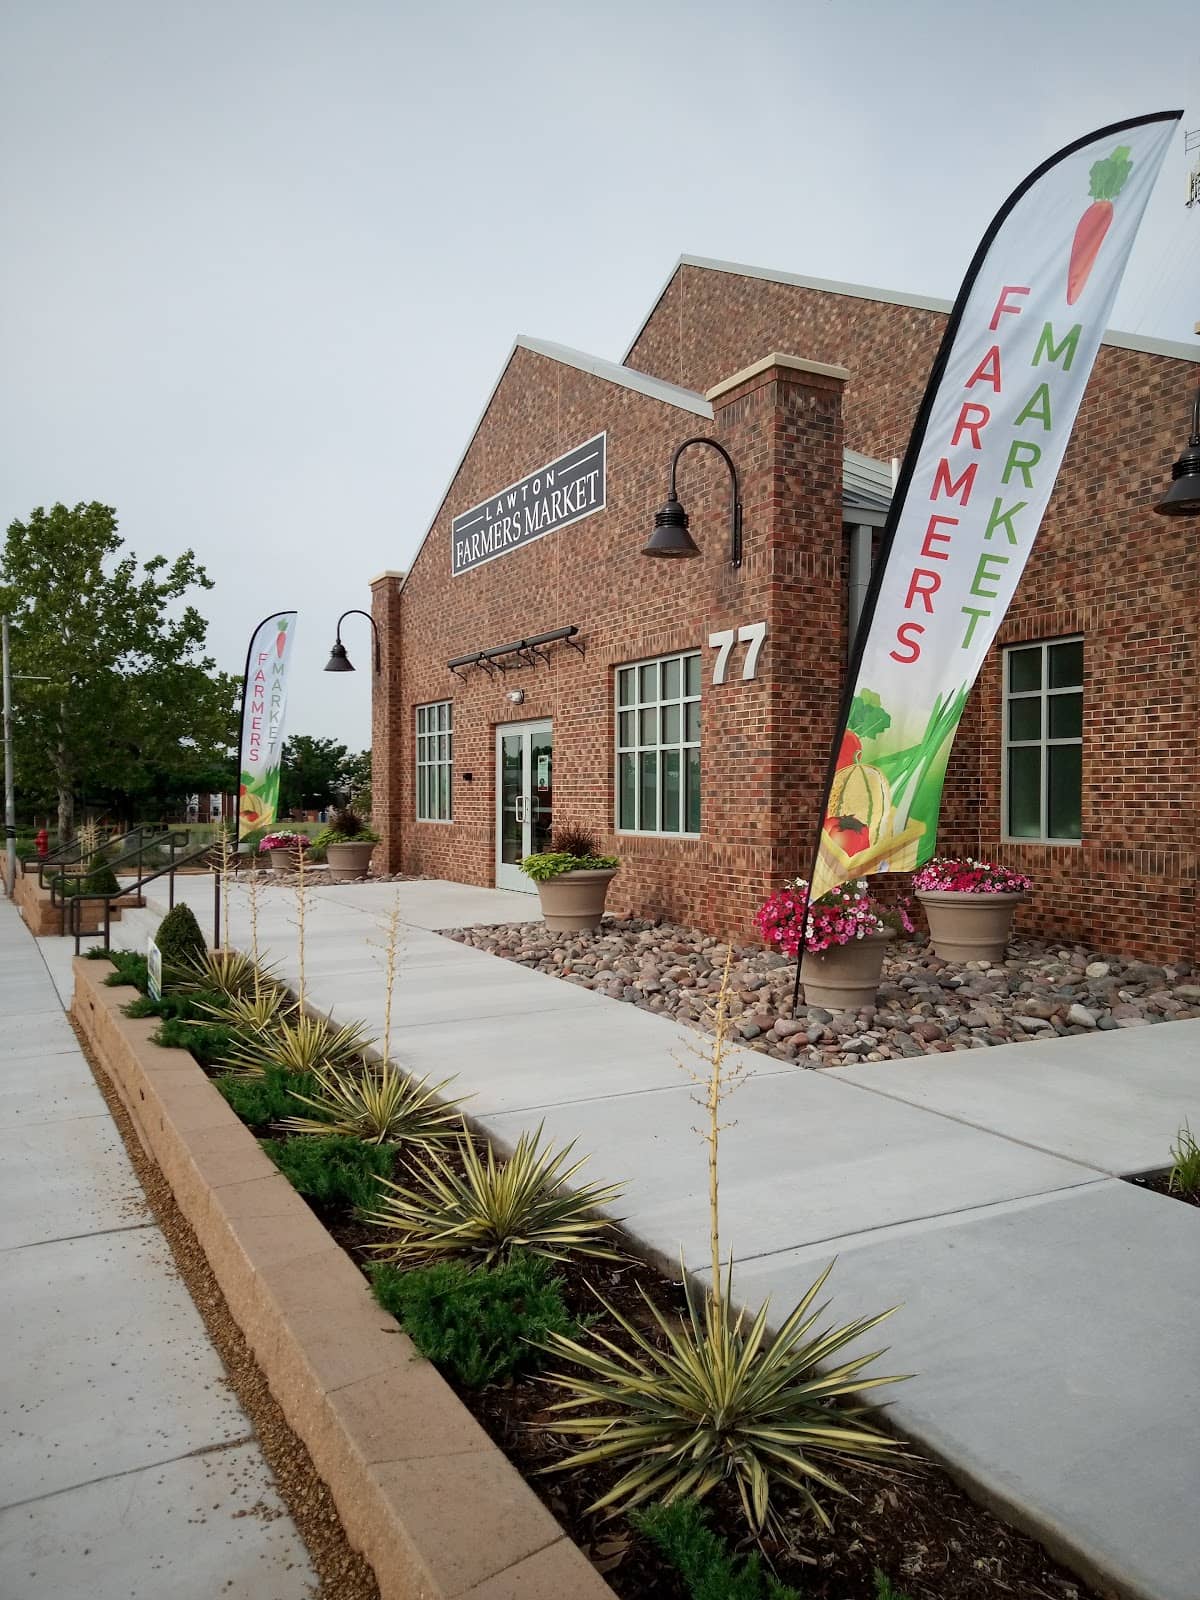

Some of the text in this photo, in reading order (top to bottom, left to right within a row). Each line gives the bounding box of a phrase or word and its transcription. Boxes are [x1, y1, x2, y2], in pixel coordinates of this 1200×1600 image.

[456, 470, 599, 568] FARMERS MARKET
[485, 469, 555, 521] LAWTON
[889, 286, 1031, 664] FARMERS
[961, 321, 1083, 649] MARKET
[708, 622, 767, 685] 77
[249, 653, 269, 762] FARMERS
[268, 662, 285, 754] MARKET
